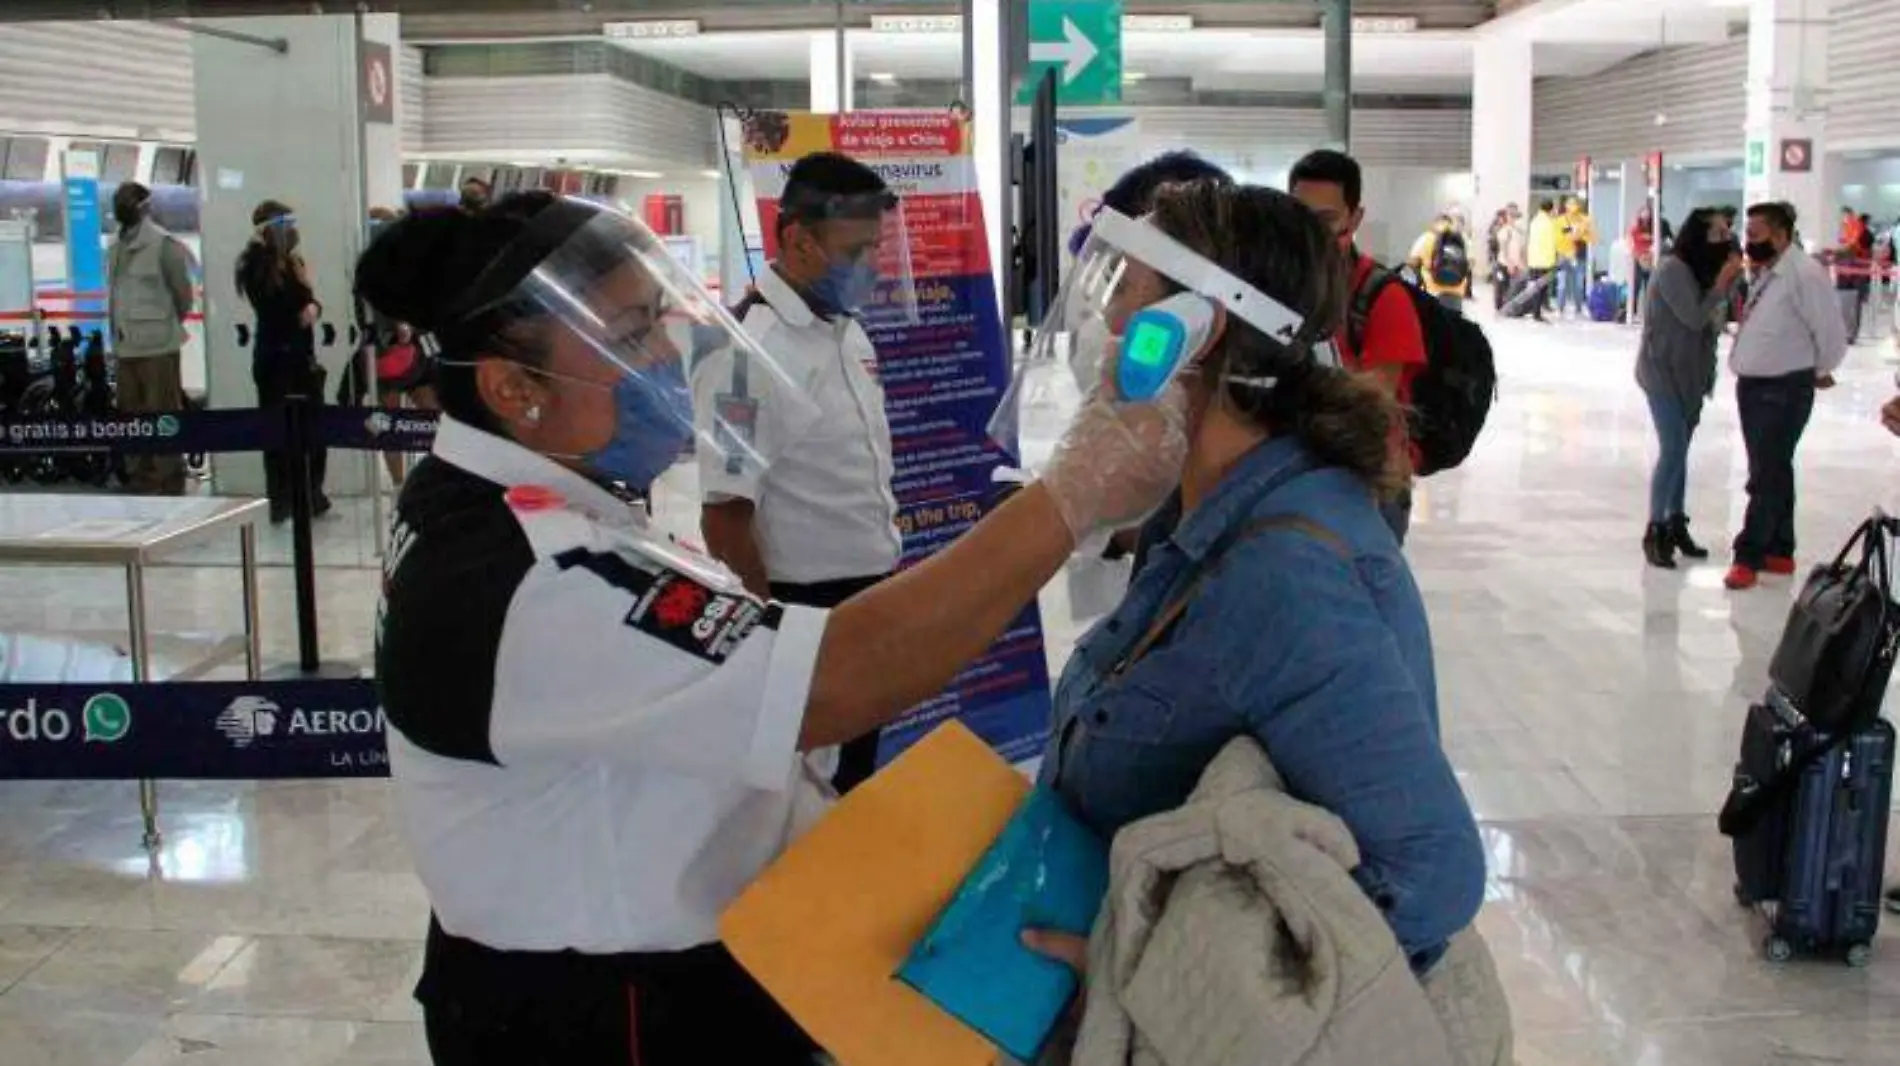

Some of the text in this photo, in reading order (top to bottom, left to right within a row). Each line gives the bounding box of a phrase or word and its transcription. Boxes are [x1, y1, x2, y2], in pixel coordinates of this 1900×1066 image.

[839, 131, 859, 146] de
[908, 131, 946, 147] China
[8, 423, 69, 444] gratis
[74, 423, 87, 439] a
[92, 418, 154, 439] bordo
[330, 752, 353, 768] LA
